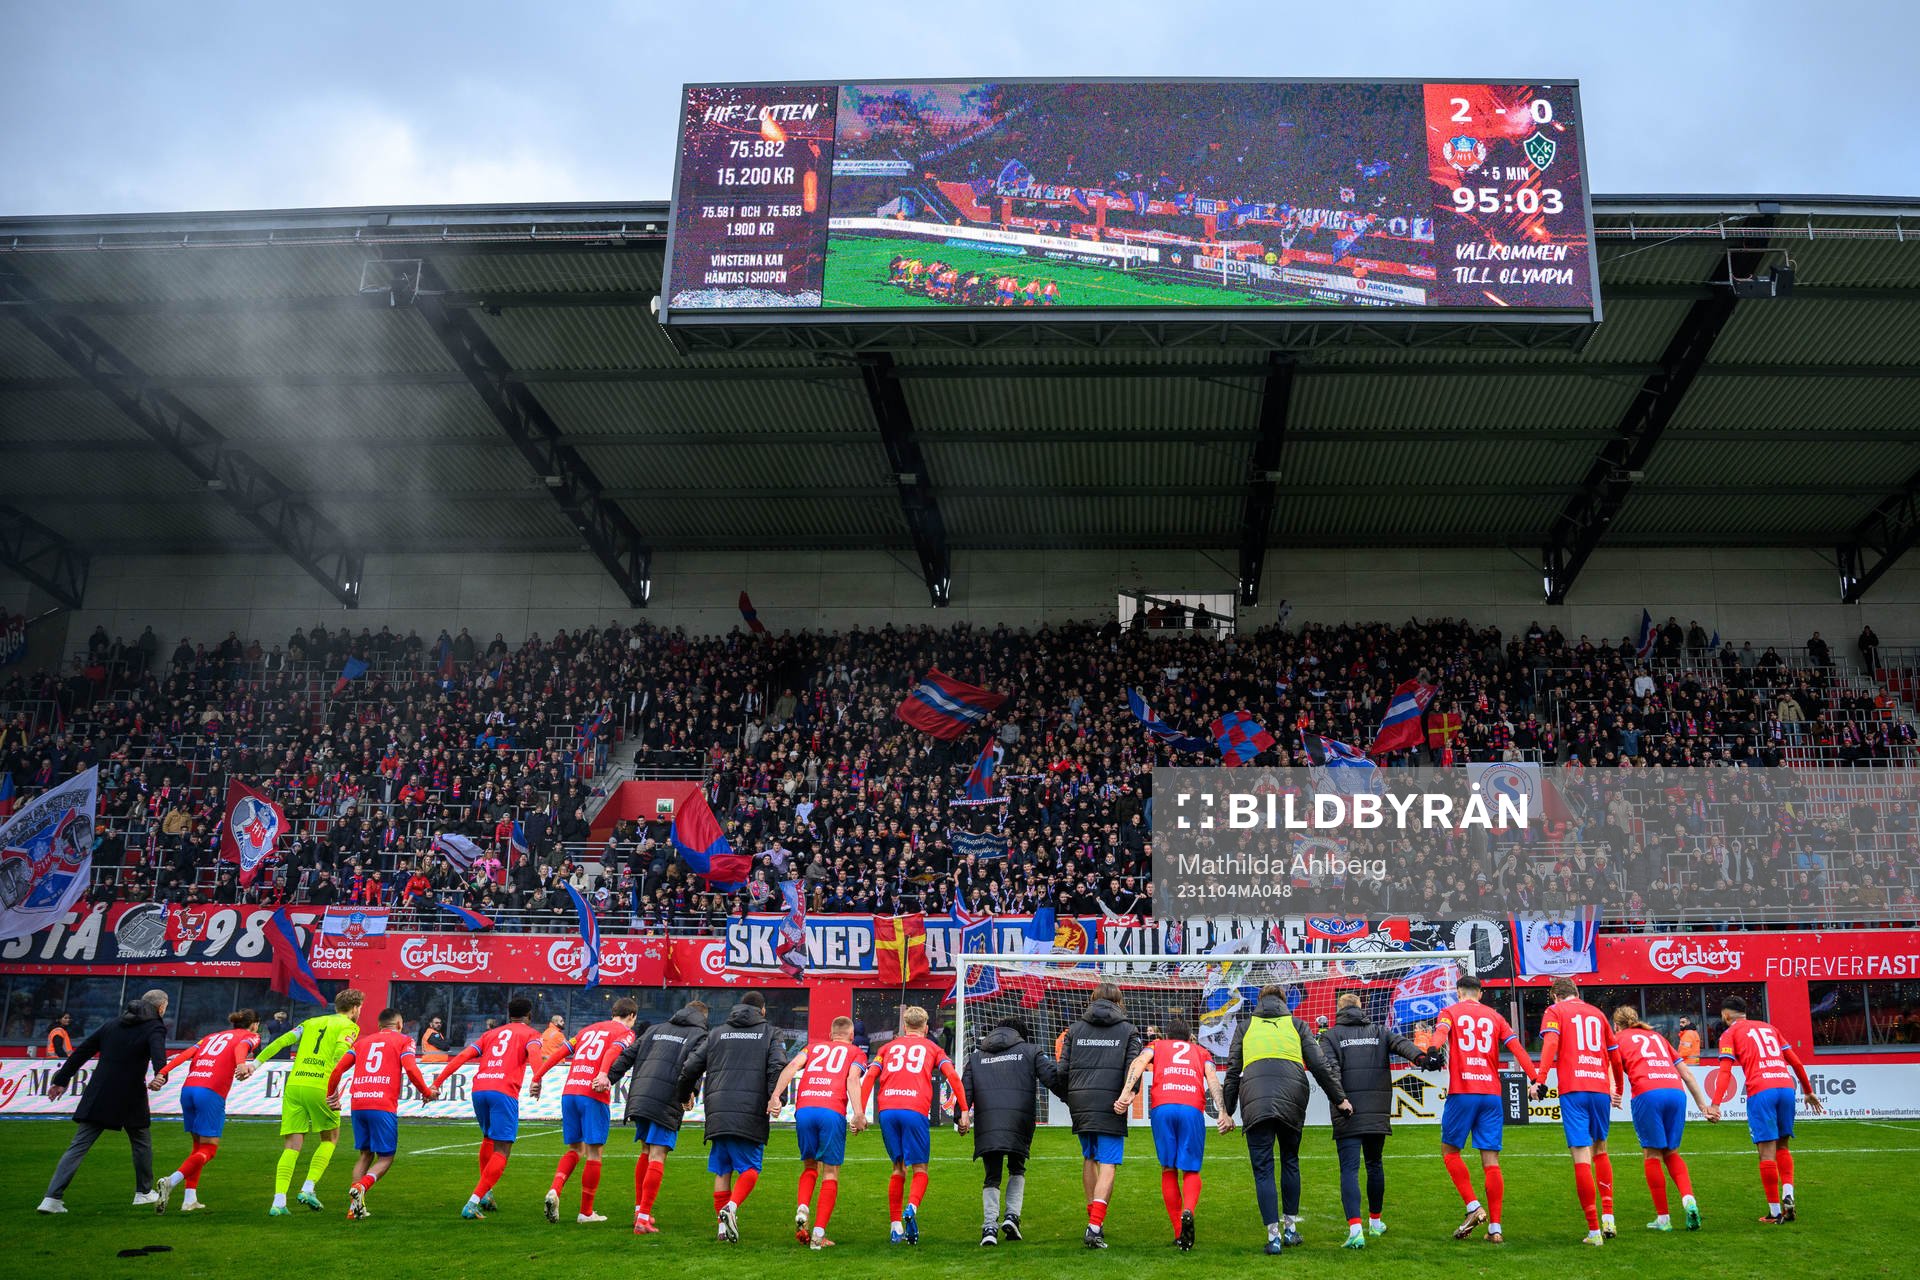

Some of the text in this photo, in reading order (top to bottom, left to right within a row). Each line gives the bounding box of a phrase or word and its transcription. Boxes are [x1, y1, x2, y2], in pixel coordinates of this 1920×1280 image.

[704, 103, 819, 123] HIF-LOTTEN
[1450, 98, 1472, 122] 2
[1530, 99, 1552, 123] 0
[729, 139, 785, 158] 75.582
[717, 167, 795, 186] 15.200 KR
[1506, 167, 1529, 180] MIN
[702, 205, 802, 218] 75.581 OCH 75.583
[1452, 187, 1564, 214] 95:03
[726, 222, 775, 236] 1.900 KR
[711, 254, 784, 267] VINSTERNA KAN
[704, 271, 744, 284] HÄMTAS
[750, 271, 787, 284] SHOPEN
[1452, 266, 1494, 284] TILL
[1499, 267, 1574, 285] OLYMPIA
[312, 960, 352, 969] diabetes
[400, 938, 493, 974] Carlsberg
[1649, 939, 1743, 973] Carlsberg
[200, 1033, 234, 1056] 16
[313, 1026, 328, 1054] 1
[491, 1029, 512, 1057] 3
[1077, 1039, 1114, 1047] HELSINGBORGS
[1457, 1015, 1494, 1053] 33
[1571, 1014, 1602, 1052] 10
[1747, 1028, 1781, 1058] 15
[365, 1042, 385, 1073] 5
[575, 1030, 609, 1061] 25
[1172, 1041, 1191, 1065] 2
[1631, 1034, 1669, 1058] 21
[807, 1044, 848, 1073] 20
[887, 1044, 927, 1073] 39
[808, 1076, 832, 1086] OLSSON
[1509, 1083, 1520, 1119] SELECT
